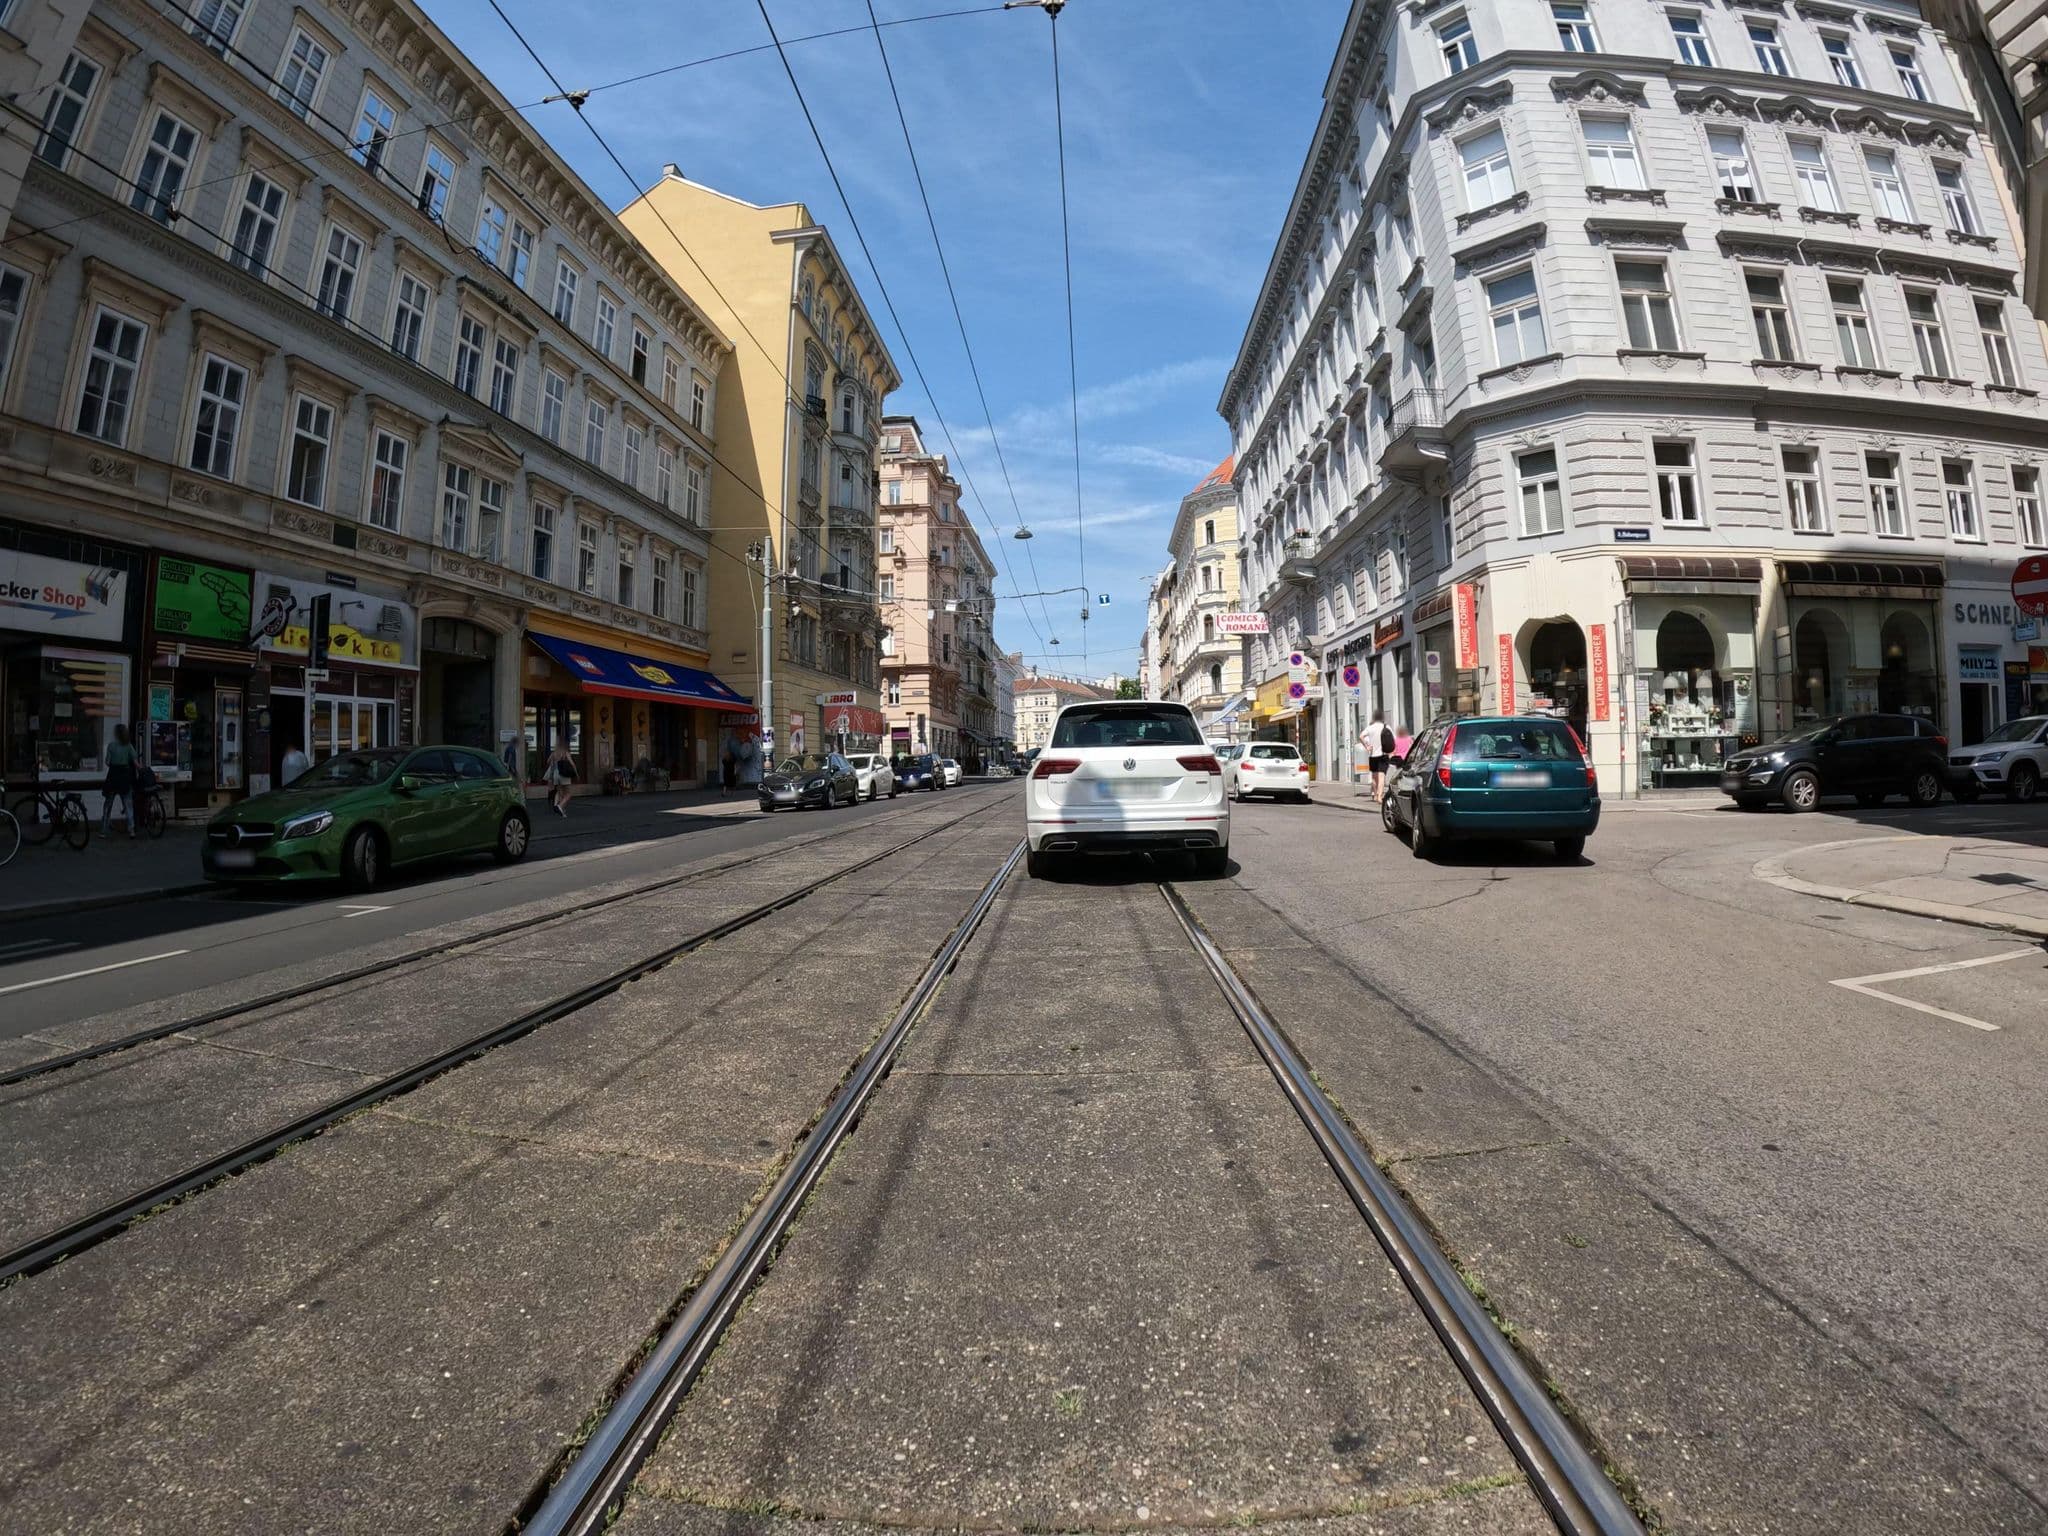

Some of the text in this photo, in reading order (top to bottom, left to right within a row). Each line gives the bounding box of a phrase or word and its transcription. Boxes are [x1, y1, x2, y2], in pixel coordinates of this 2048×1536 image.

[43, 586, 85, 610] Shop
[1459, 593, 1470, 654] LIVING CORNER
[1501, 644, 1511, 711] LIVING CORNER
[1592, 635, 1605, 706] LIVING CORNER
